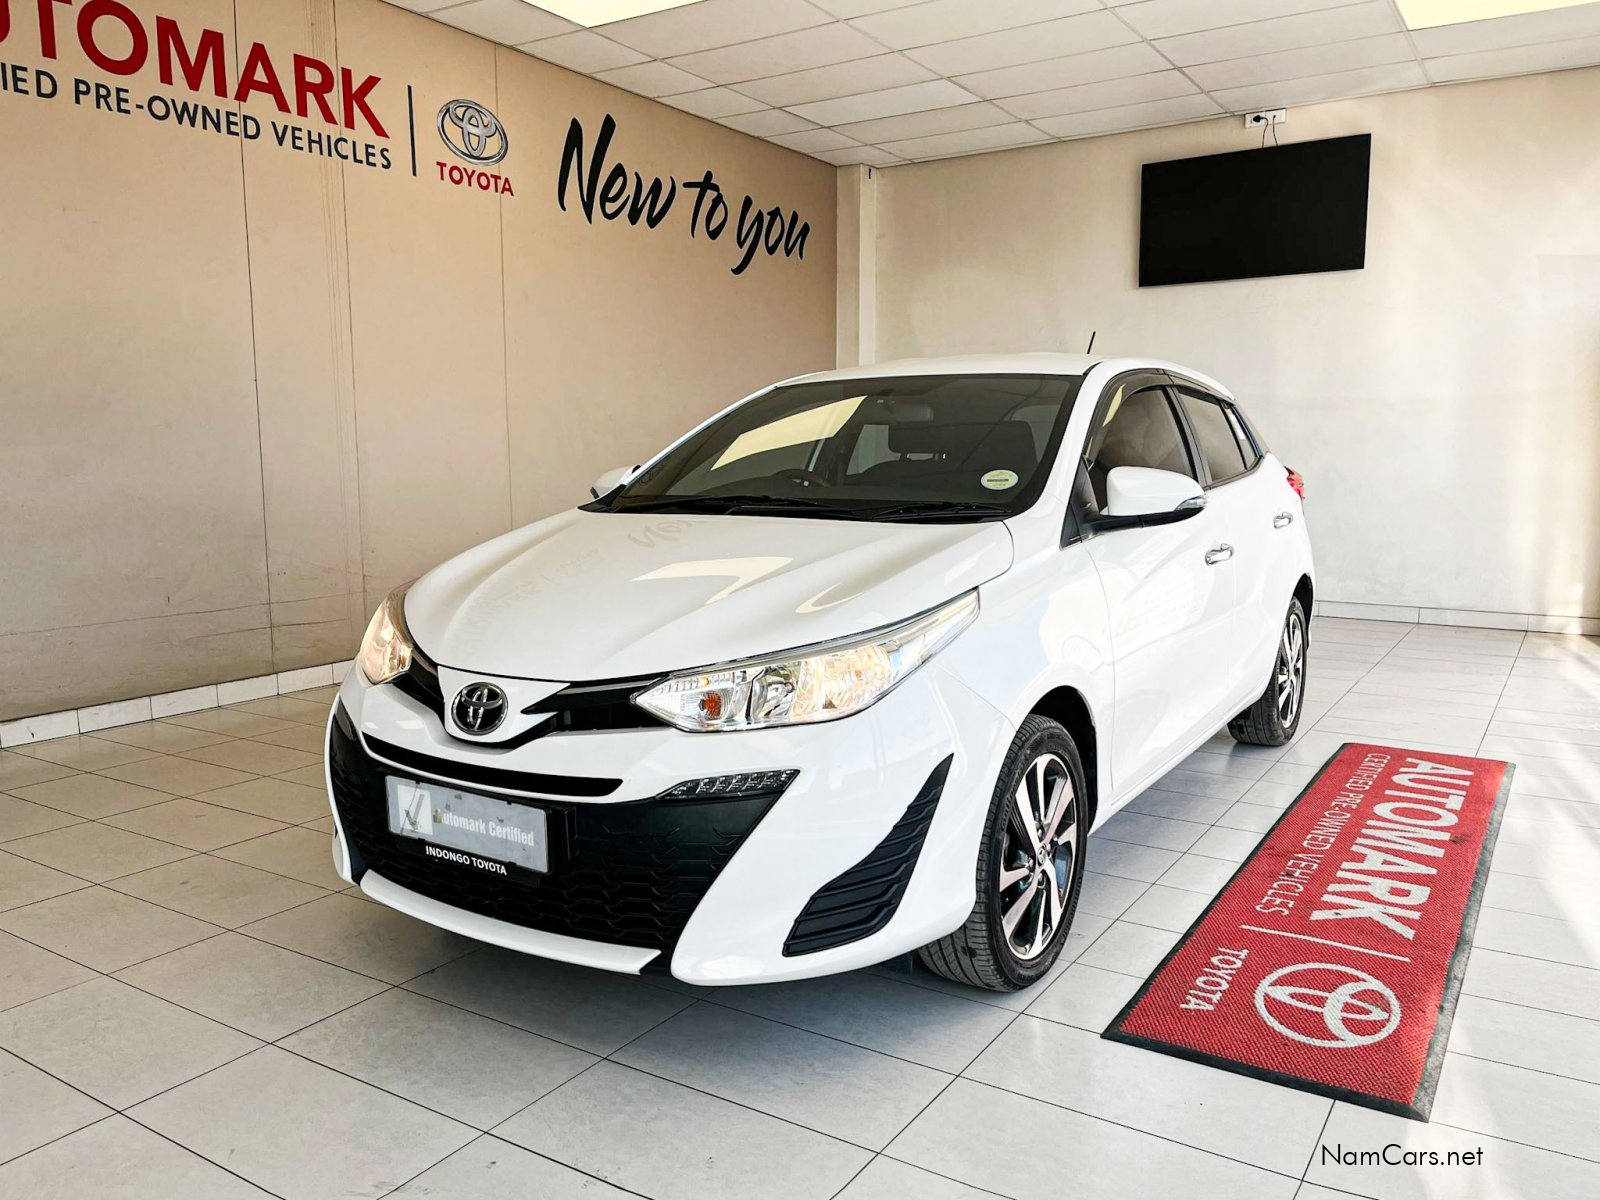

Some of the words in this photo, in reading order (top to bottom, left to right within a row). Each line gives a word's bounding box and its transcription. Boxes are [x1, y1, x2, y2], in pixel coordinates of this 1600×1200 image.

[74, 78, 261, 140] PRE-OWNED
[271, 121, 392, 170] VEHICLES
[436, 161, 515, 197] TOYOTA
[557, 113, 676, 229] New
[682, 170, 728, 240] to
[731, 195, 811, 275] you
[1344, 753, 1391, 791] CERTIFIED
[488, 820, 535, 847] Certified
[1300, 791, 1364, 851] PRE-OWNED
[1309, 757, 1474, 940] AUTOMARK
[425, 845, 470, 865] INDONGO
[471, 857, 508, 876] TOYOTA
[1255, 852, 1325, 916] VEHICLES
[1180, 945, 1249, 1012] TOYOTA
